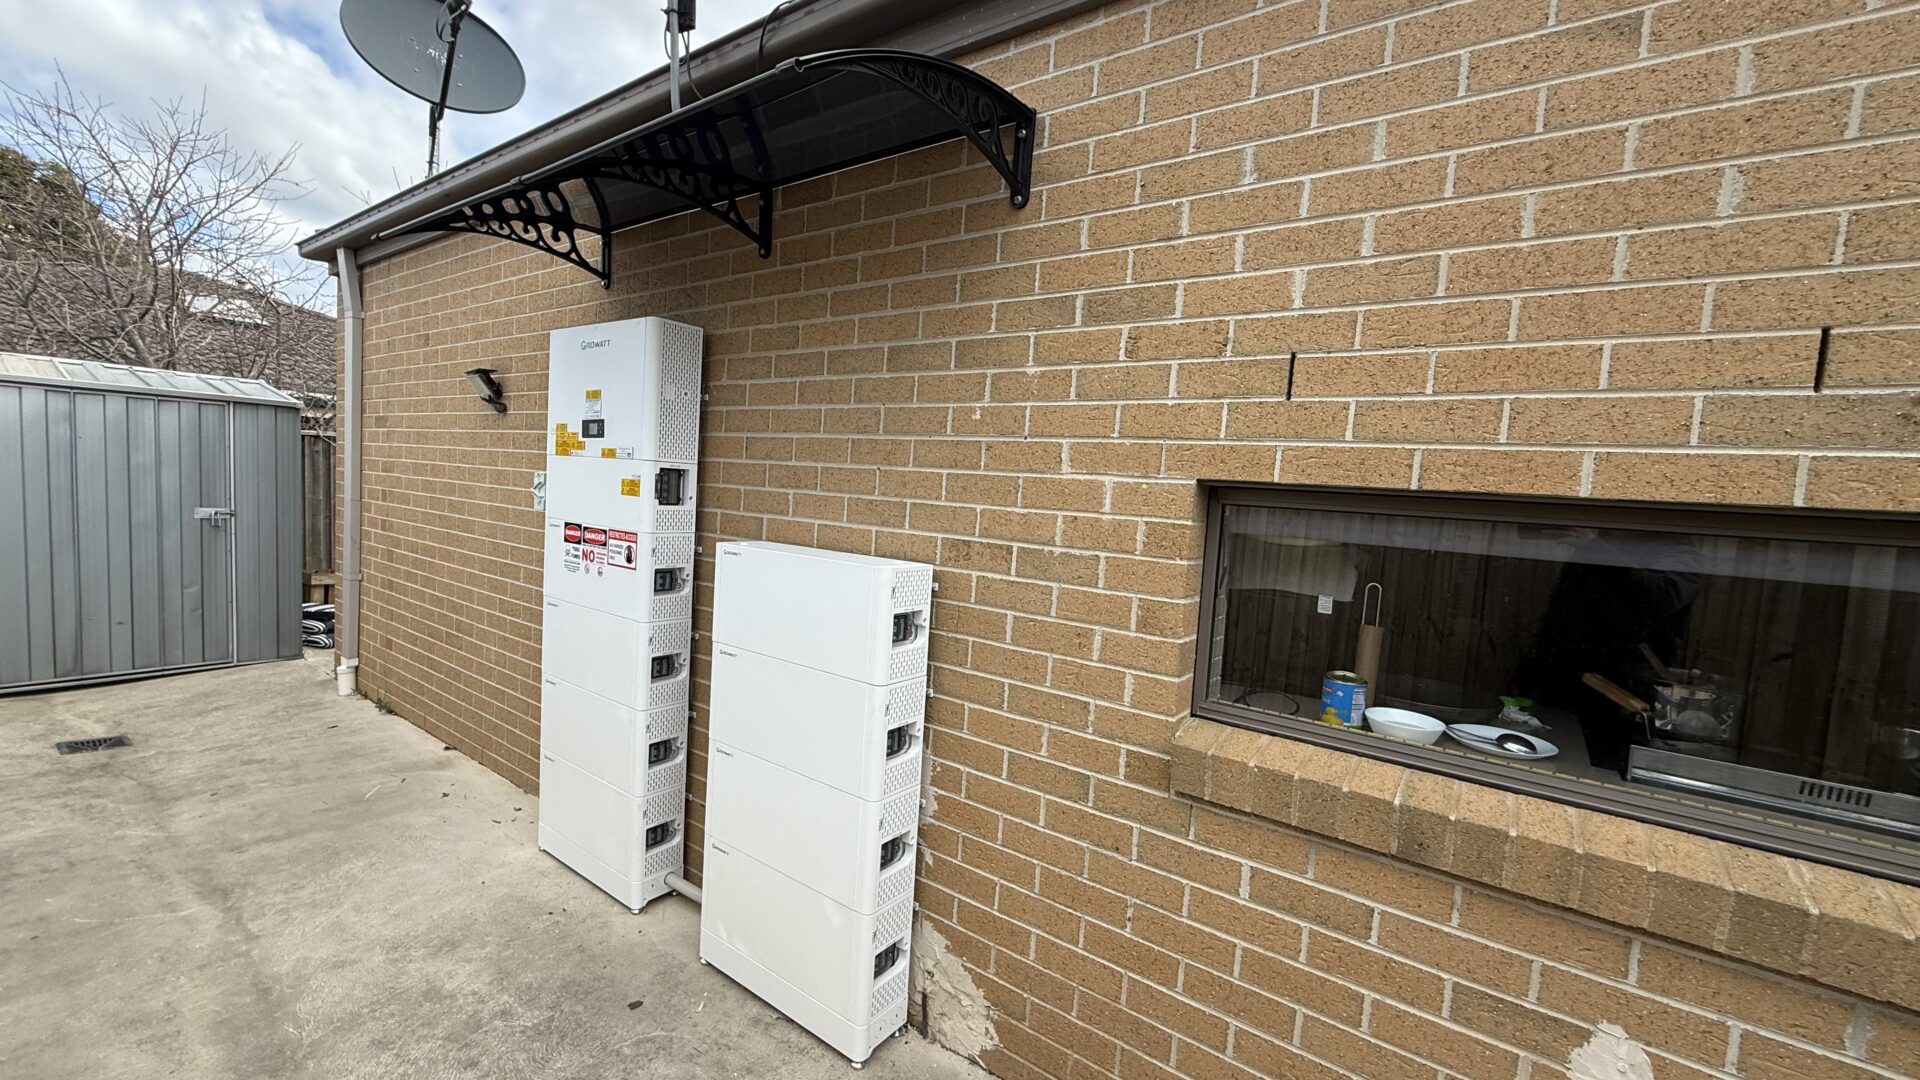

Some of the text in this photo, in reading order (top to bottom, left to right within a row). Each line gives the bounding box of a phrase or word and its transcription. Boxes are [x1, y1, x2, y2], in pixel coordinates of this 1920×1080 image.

[580, 339, 611, 350] GROWATT
[565, 529, 581, 537] DANGER
[584, 531, 606, 541] DANGER
[582, 547, 596, 563] NO
